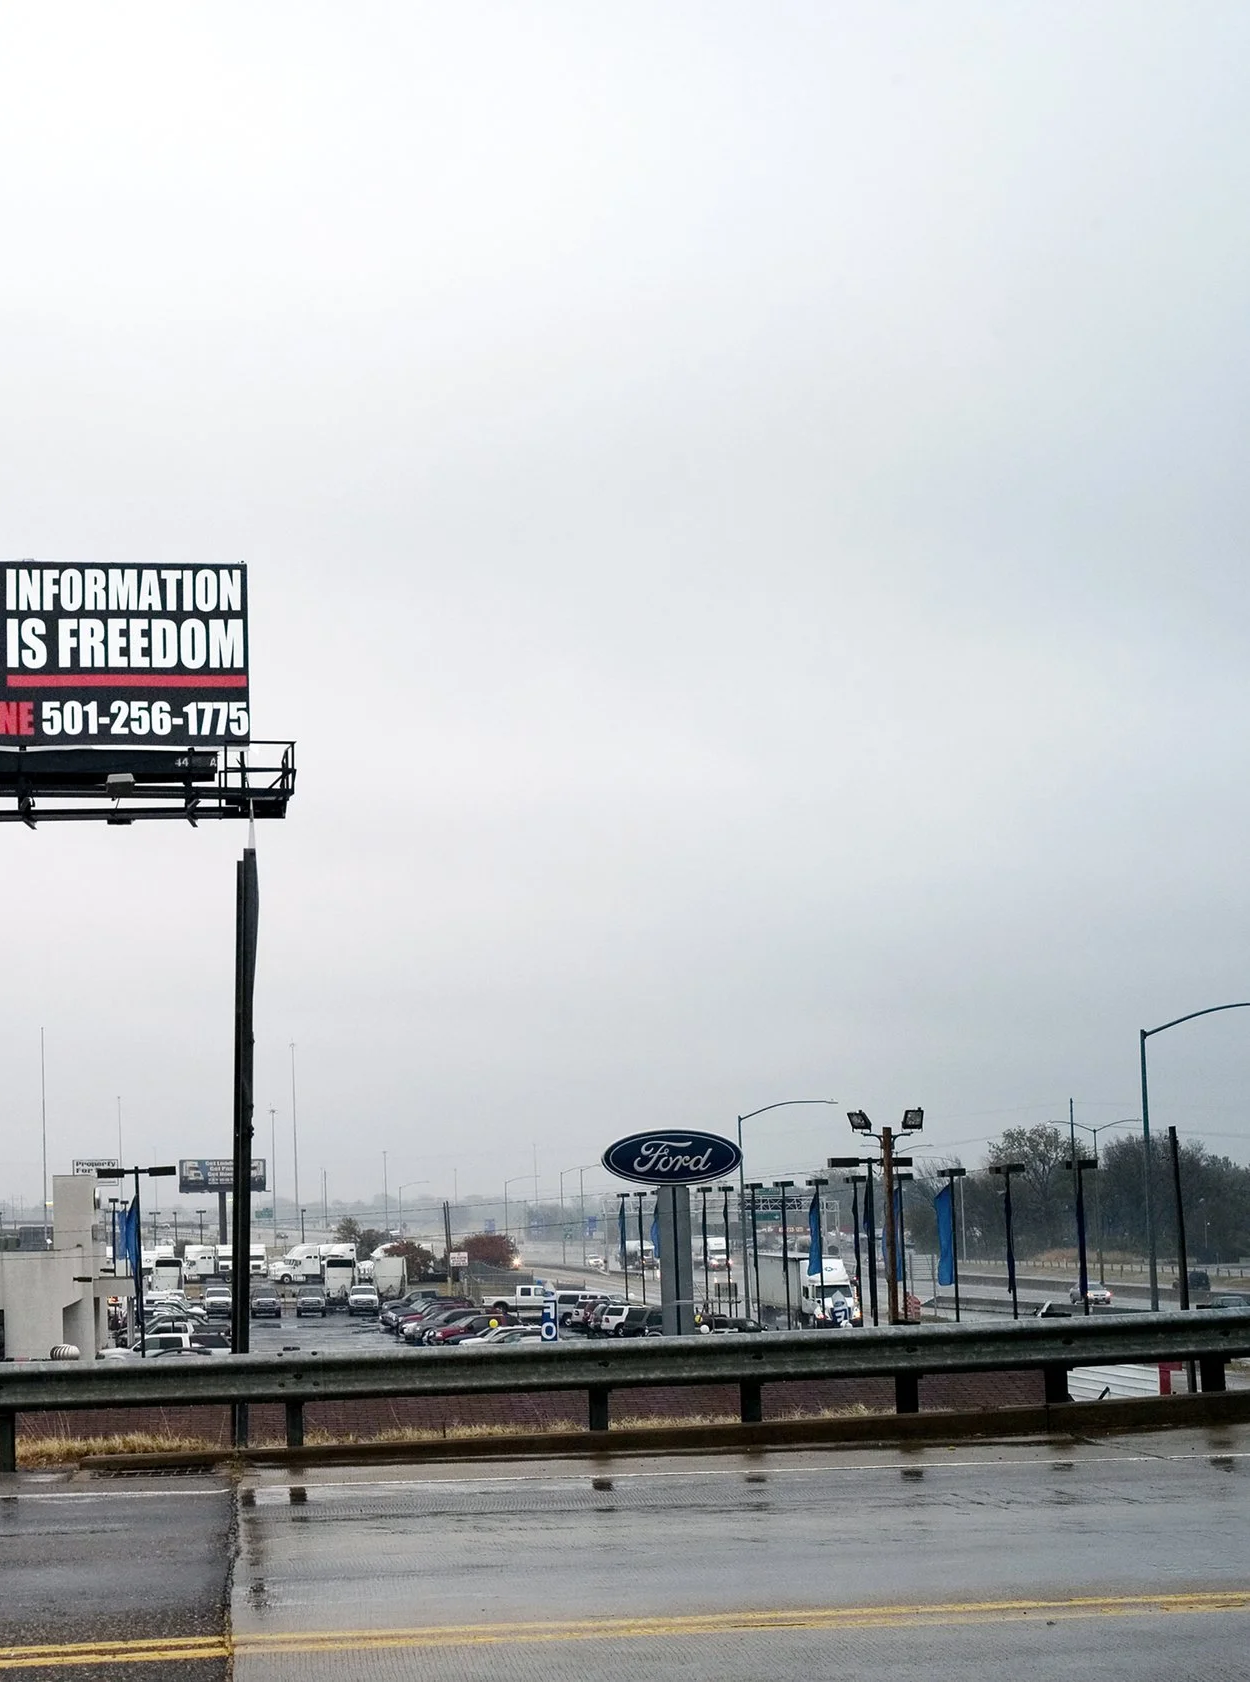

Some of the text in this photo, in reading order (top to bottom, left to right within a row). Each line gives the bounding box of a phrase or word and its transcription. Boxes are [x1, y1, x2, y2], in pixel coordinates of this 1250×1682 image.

[6, 568, 242, 612] INFORMATION
[6, 617, 244, 669] IS FREEDOM
[41, 700, 250, 737] 501-256-1775
[633, 1140, 712, 1172] Ford
